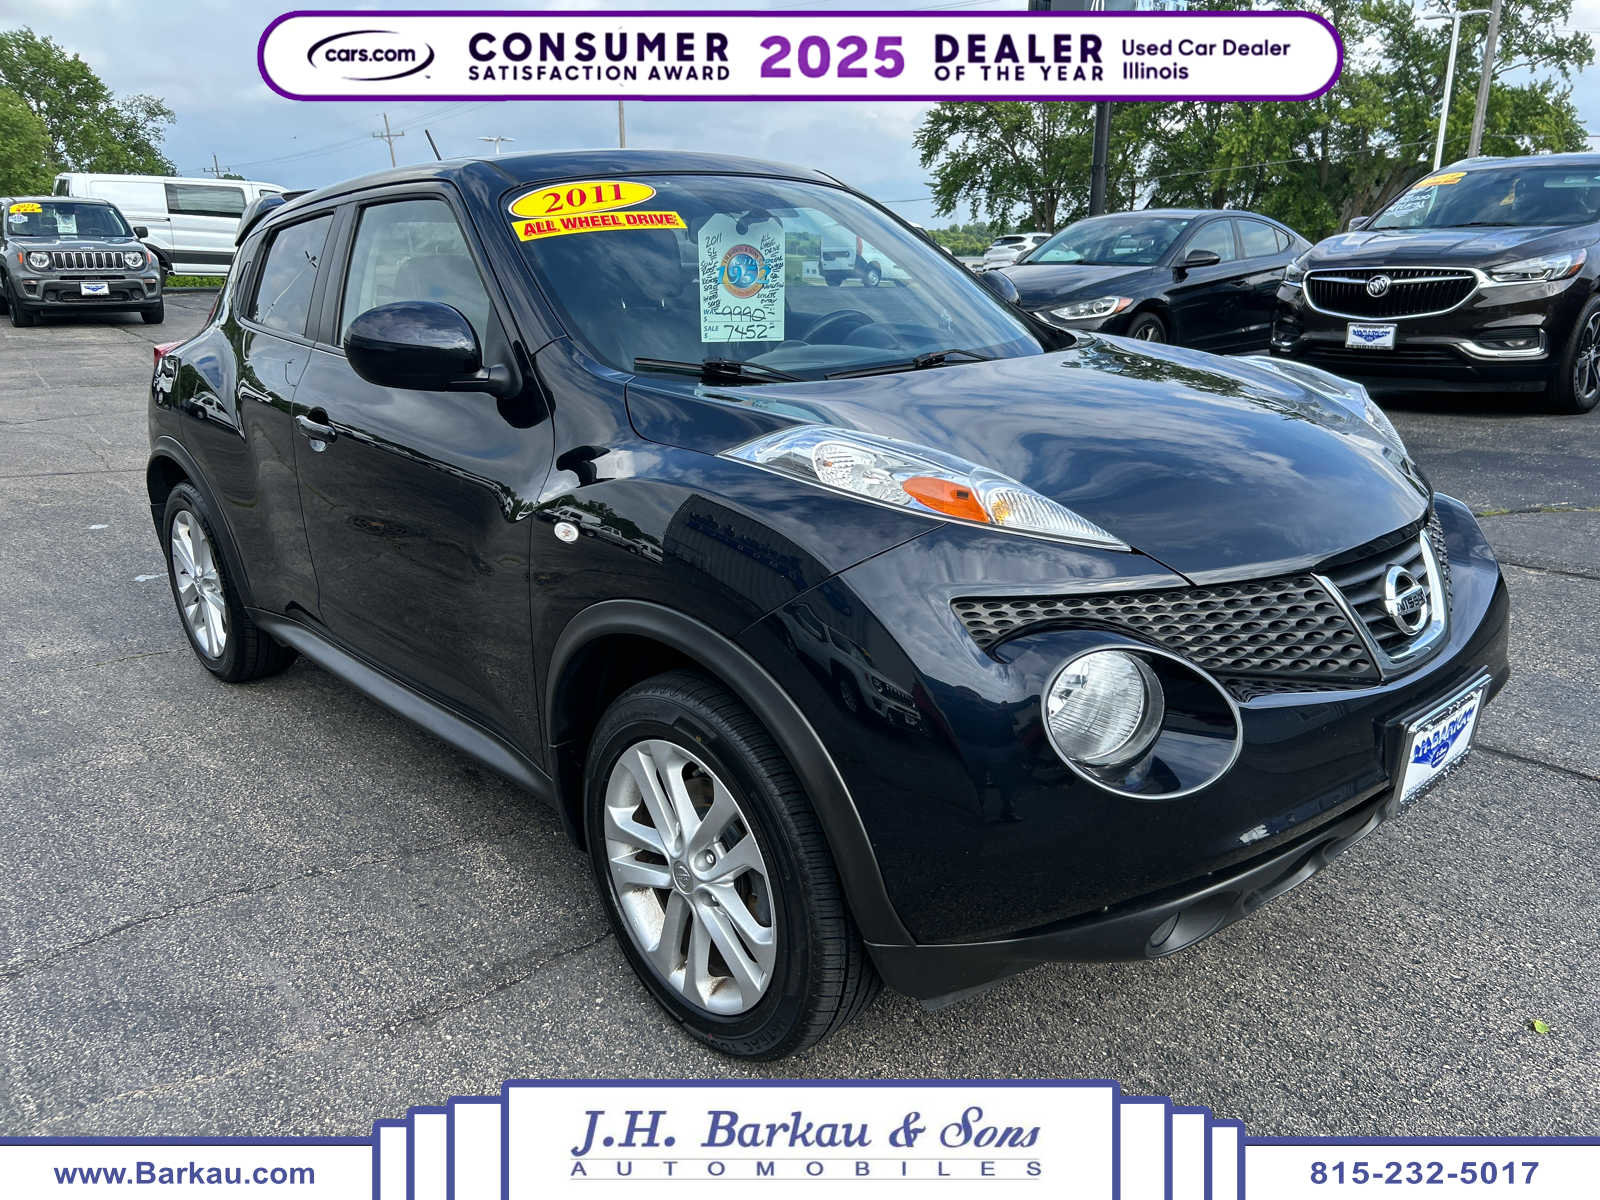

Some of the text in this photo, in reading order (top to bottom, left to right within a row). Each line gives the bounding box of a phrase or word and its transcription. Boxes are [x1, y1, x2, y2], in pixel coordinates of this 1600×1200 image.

[542, 183, 627, 214] 2011
[523, 213, 679, 237] ALL WHEEL DRIVE
[723, 324, 768, 343] 7452
